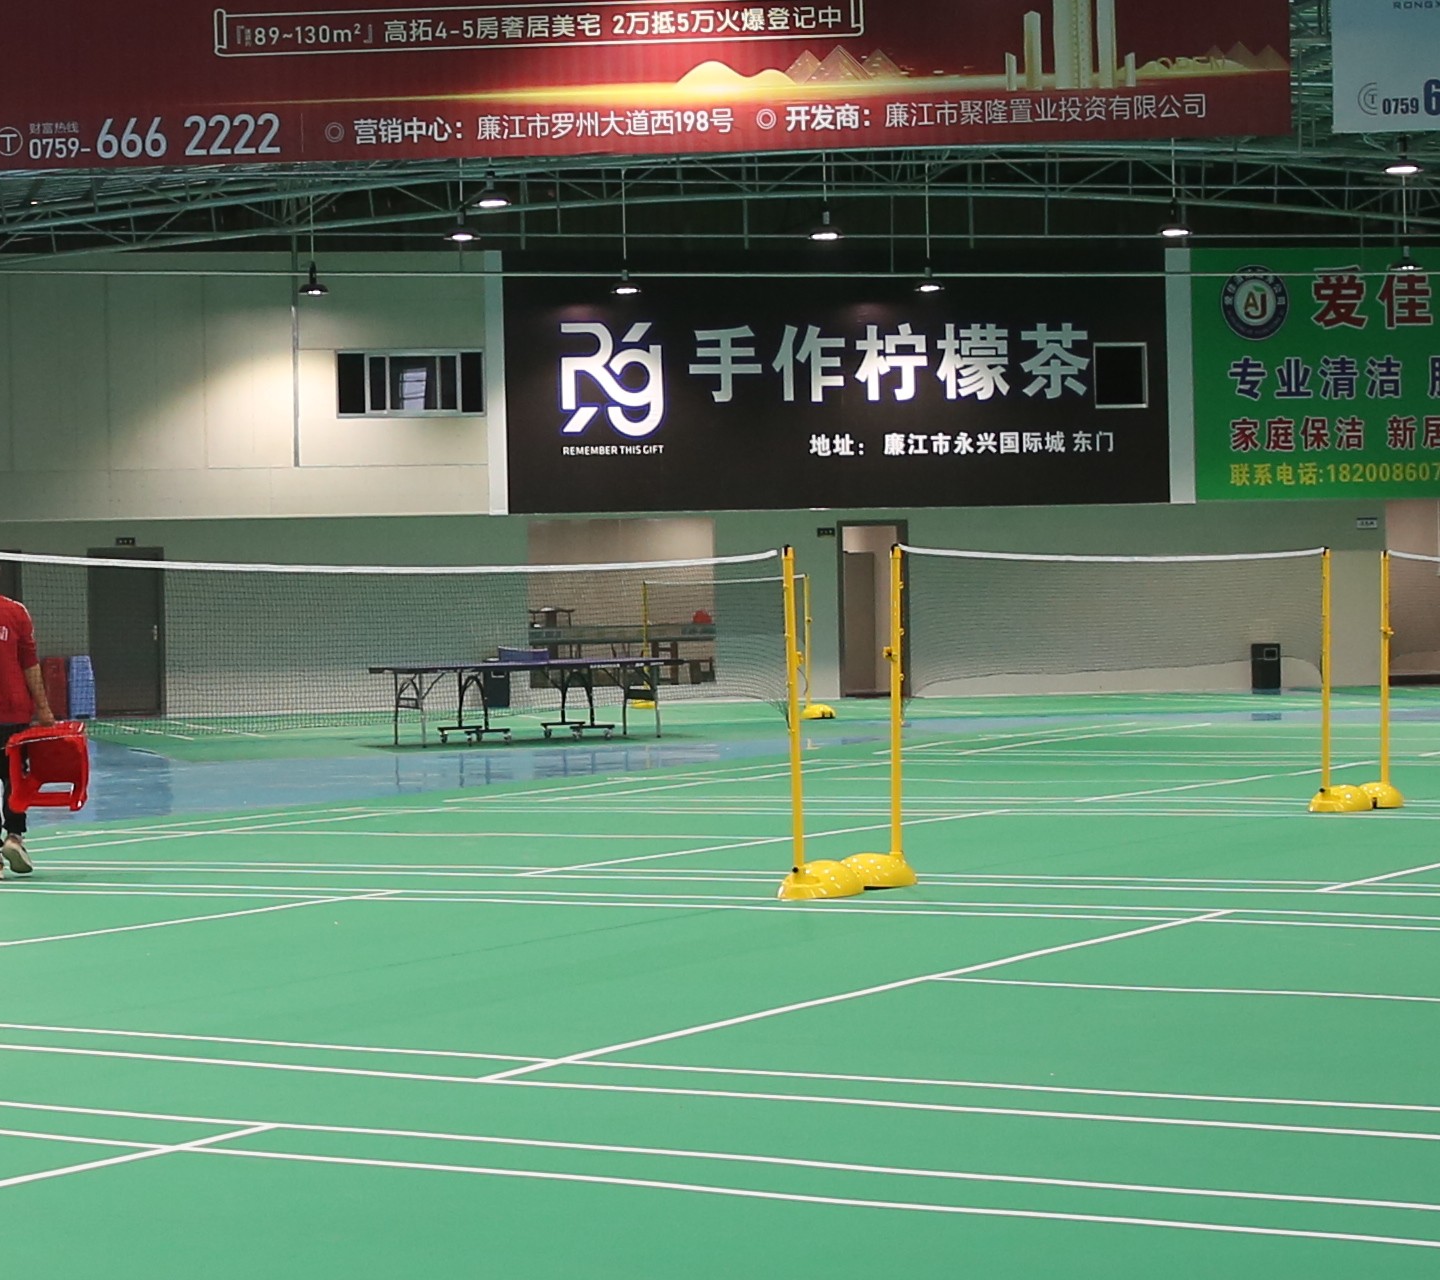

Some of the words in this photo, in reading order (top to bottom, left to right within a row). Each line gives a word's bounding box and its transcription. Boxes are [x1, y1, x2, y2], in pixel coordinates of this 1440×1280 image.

[384, 12, 602, 44] 高拓4-5房奢居美宅
[612, 4, 842, 35] 2万抵5万火爆登记中
[786, 104, 874, 132] 开发商：
[884, 92, 1208, 129] 廉江市聚隆置业投资有限公司
[1382, 97, 1419, 116] 0759
[29, 122, 80, 135] 财富热线
[184, 113, 281, 156] 2222
[475, 107, 734, 142] 廉江市罗州大道西198号
[1243, 290, 1268, 320] AJ
[688, 322, 1091, 403] 手作柠檬茶
[1227, 355, 1402, 401] 专业清洁
[562, 445, 617, 455] REMEMBER
[620, 445, 641, 455] THIS
[642, 445, 664, 454] GIFT
[884, 431, 1066, 457] 廉江市永兴国际城
[1073, 430, 1114, 454] 东门
[1230, 417, 1364, 452] 家庭保洁
